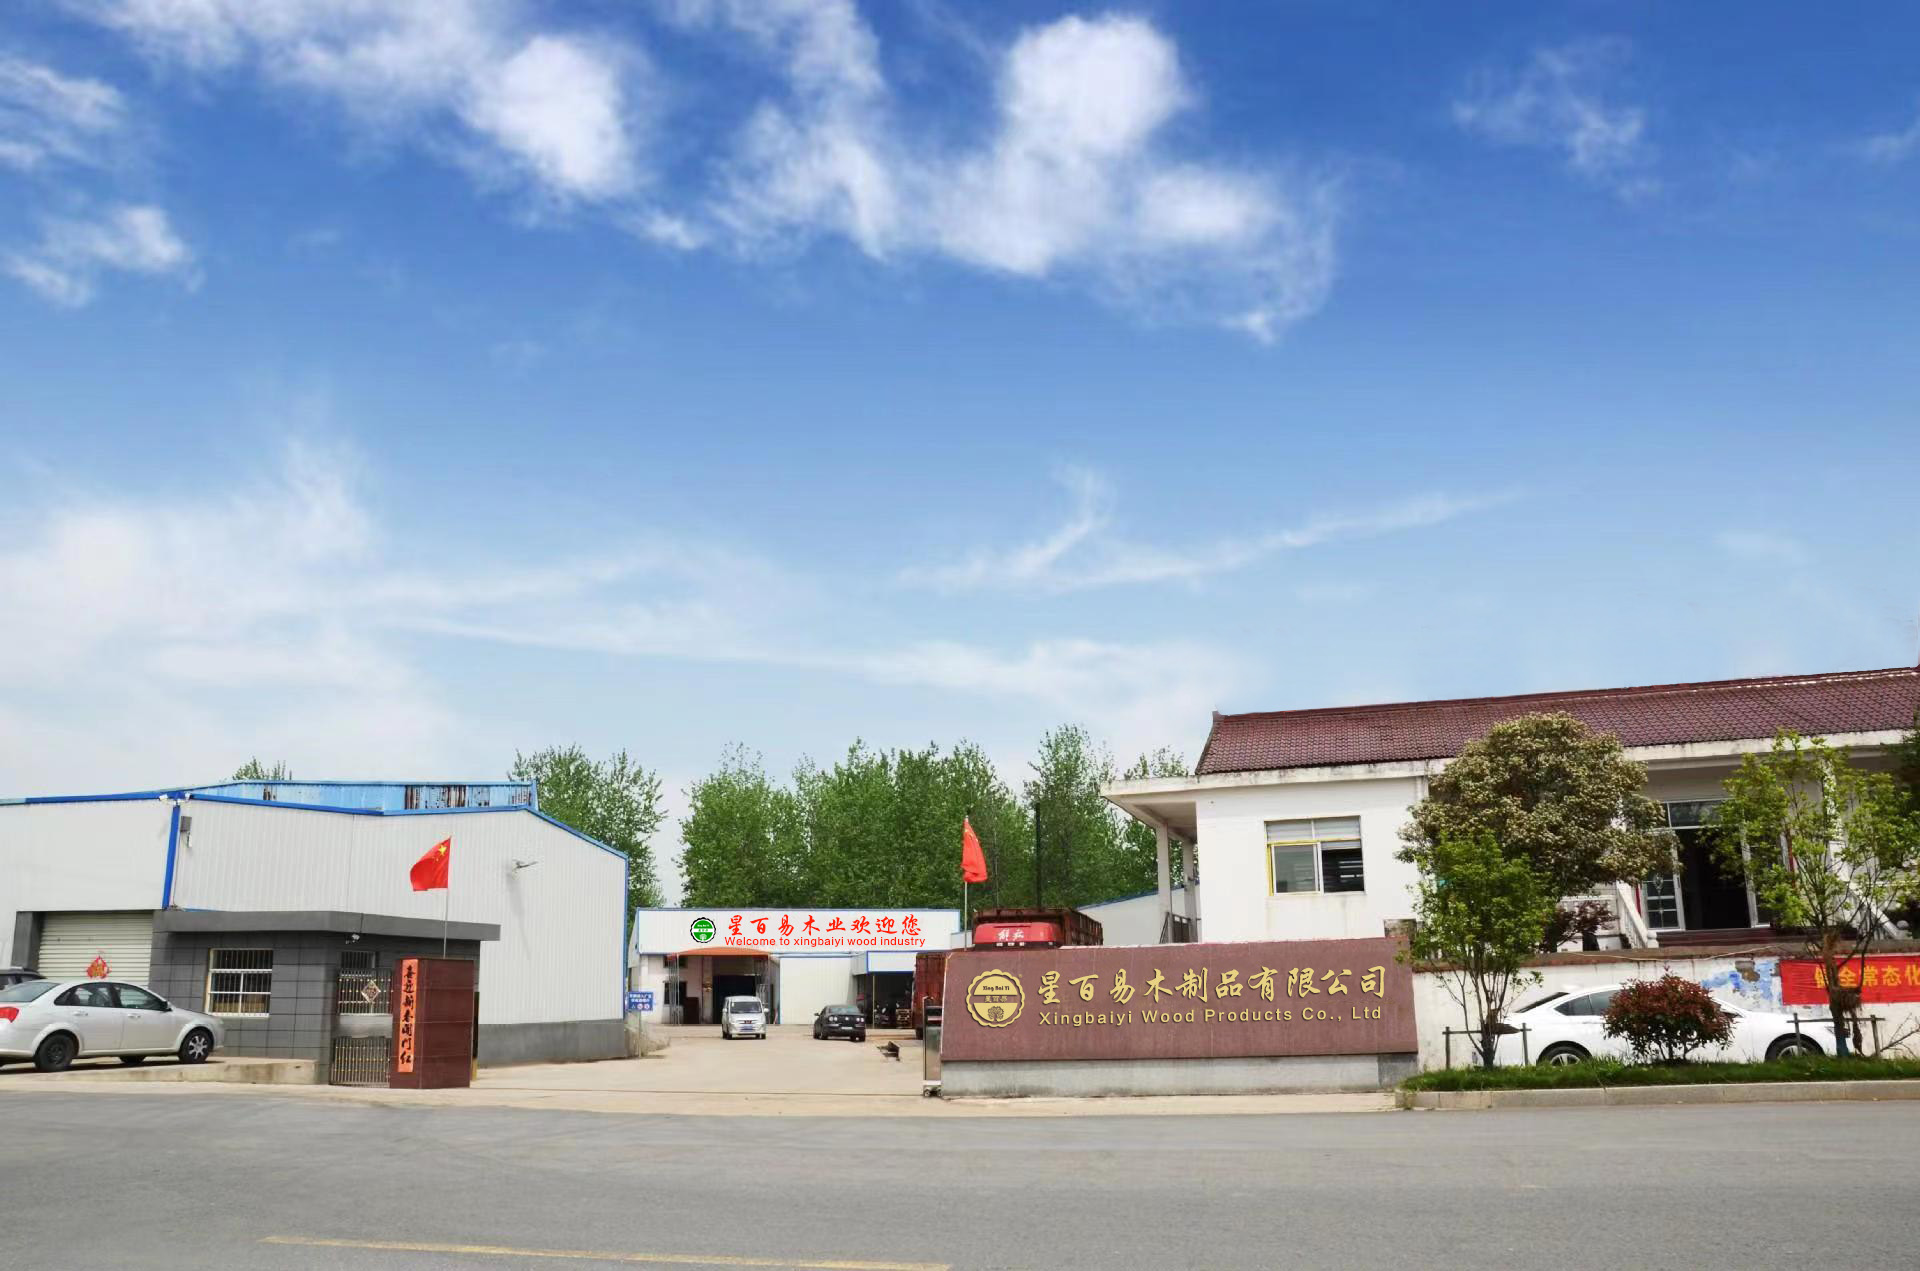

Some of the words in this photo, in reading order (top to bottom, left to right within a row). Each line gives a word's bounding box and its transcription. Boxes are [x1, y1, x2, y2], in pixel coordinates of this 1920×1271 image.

[728, 914, 922, 936] 星百易木业欢迎您
[724, 936, 776, 946] Welcome
[779, 937, 790, 946] to
[793, 936, 844, 948] xingbaiyi
[847, 936, 877, 946] wood
[880, 936, 926, 948] industry
[1038, 965, 1386, 1005] 星百易木制品有限公司
[1039, 1011, 1132, 1027] Xingbaiyi
[1142, 1009, 1195, 1023] Wood
[1204, 1008, 1293, 1022] Products
[1302, 1007, 1342, 1021] Co.,
[1352, 1006, 1382, 1020] Ltd
